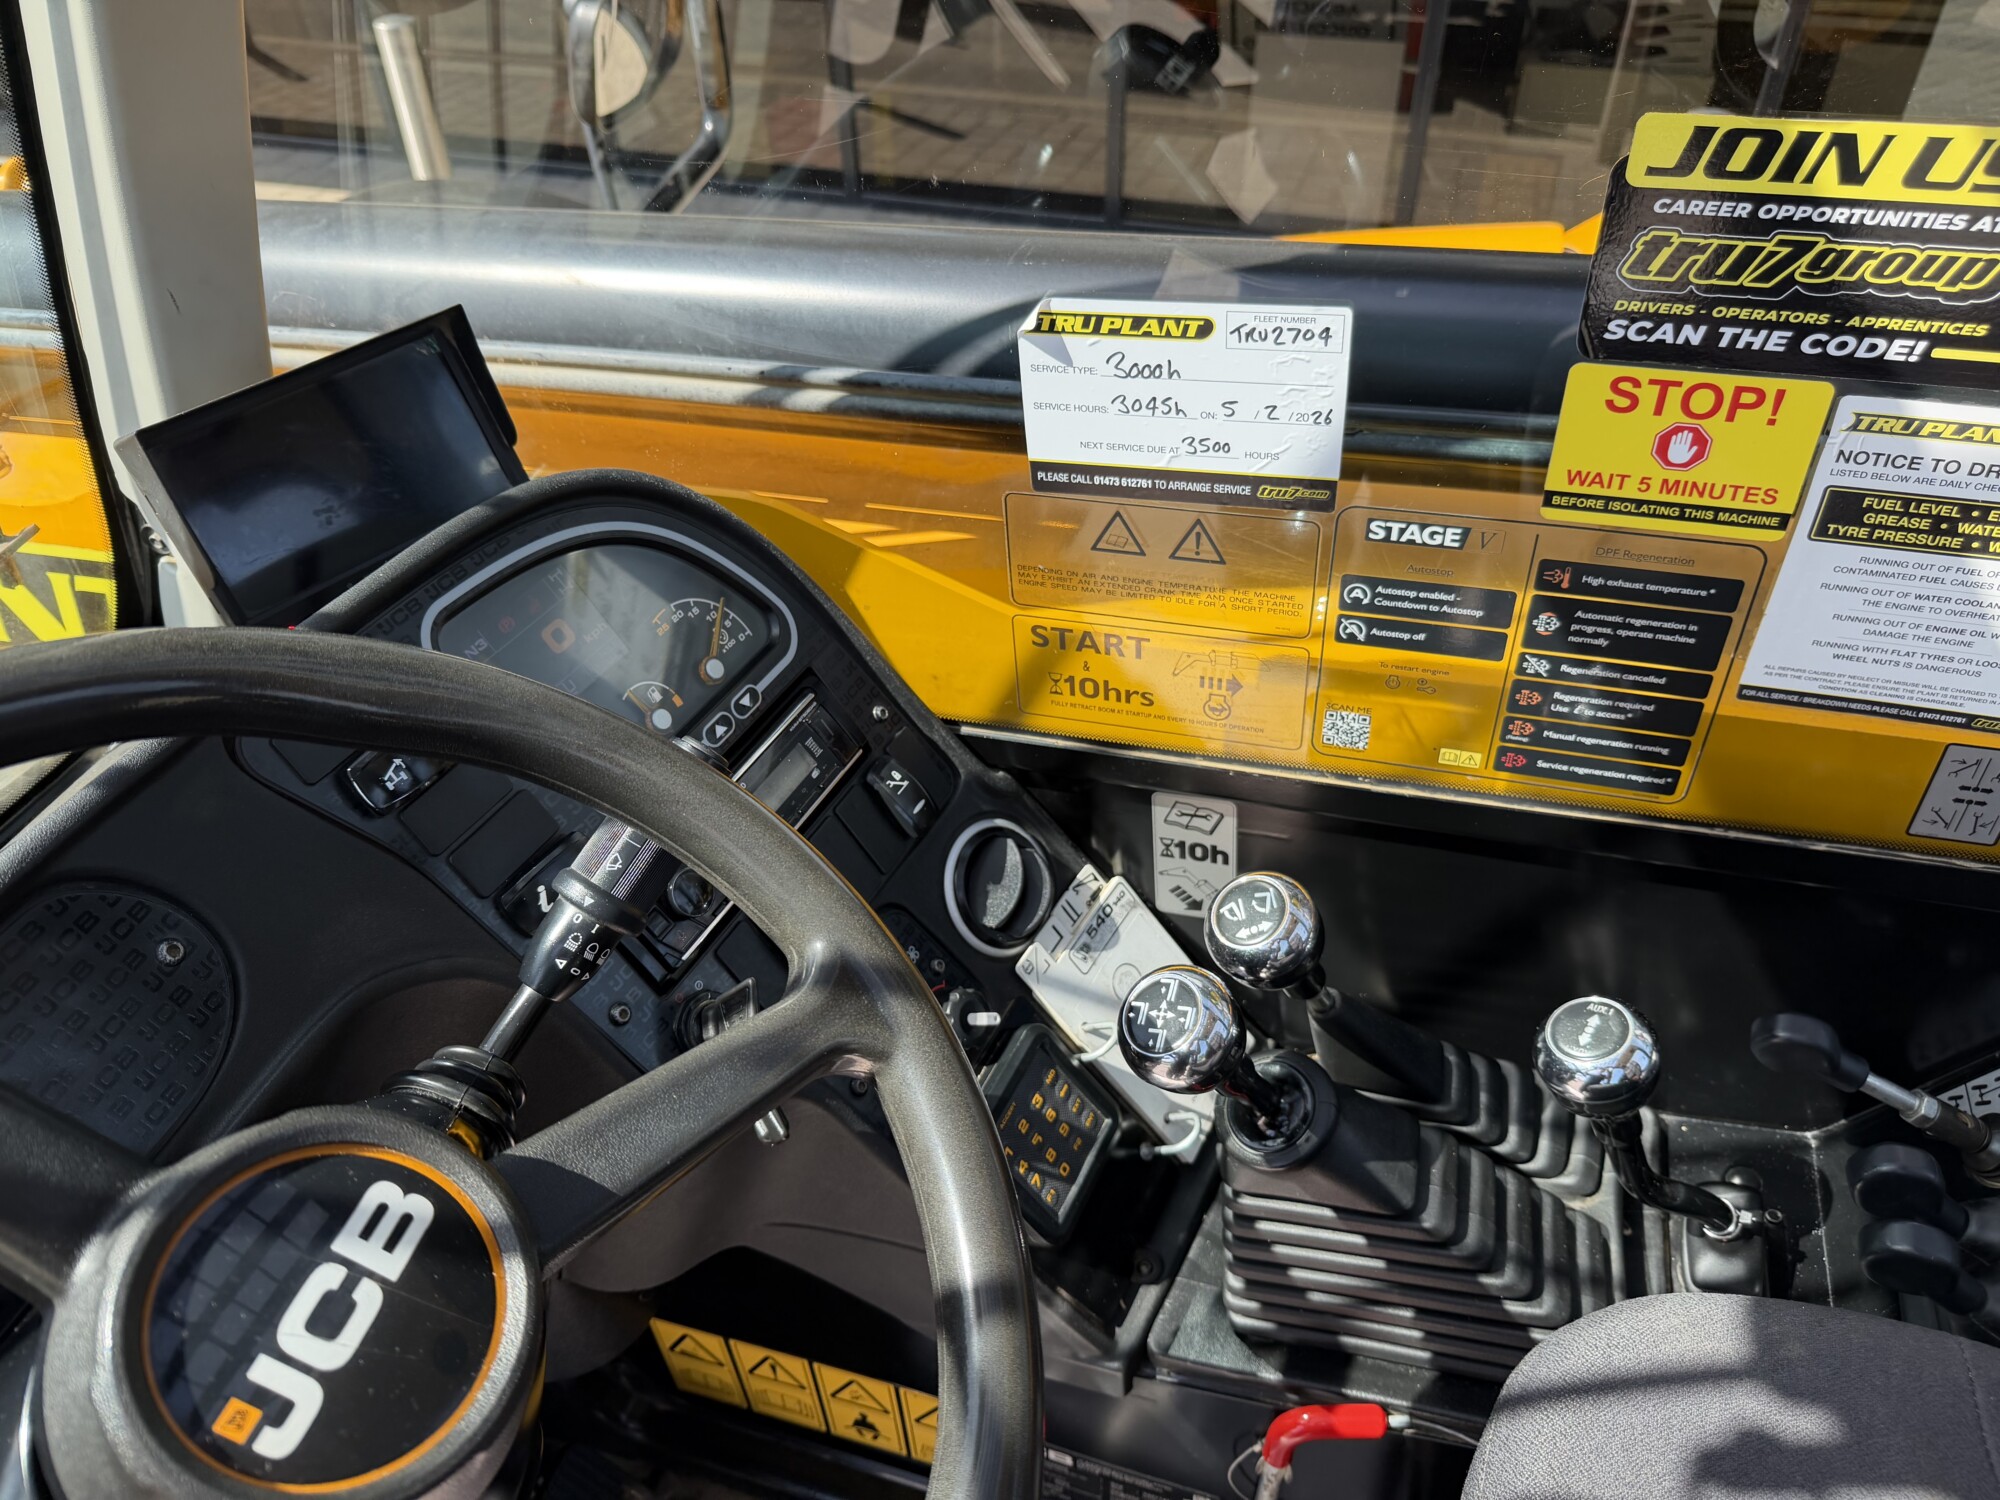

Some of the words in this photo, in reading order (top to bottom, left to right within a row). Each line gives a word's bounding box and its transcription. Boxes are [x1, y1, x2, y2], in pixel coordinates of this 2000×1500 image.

[1644, 125, 1897, 186] JOIN
[1654, 199, 1753, 219] CAREER
[1758, 203, 1968, 231] OPPORTUNITIES
[1621, 230, 2000, 293] tru7group
[1038, 314, 1099, 335] TRU
[1100, 317, 1204, 338] PLANT
[1254, 315, 1279, 323] FLEET
[1281, 316, 1317, 324] NUMBER
[1613, 300, 1696, 317] DRIVERS
[1712, 306, 1831, 325] OPERATORS
[1848, 316, 1990, 337] APPRENTICES
[1230, 324, 1332, 346] TRU2704
[1603, 319, 1704, 345] SCAN
[1717, 328, 1792, 353] THE
[1800, 334, 1933, 363] CODE!
[1031, 364, 1071, 375] SERVICE
[1073, 366, 1098, 376] TYPE:
[1106, 351, 1181, 379] 3000h
[1033, 402, 1072, 412] SERVICE
[1073, 403, 1109, 414] HOURS:
[1200, 411, 1217, 420] ON:
[1264, 405, 1280, 420] 2
[1604, 376, 1787, 426] STOP!
[1856, 415, 1920, 434] TRU
[1080, 441, 1105, 450] NEXT
[1106, 442, 1145, 453] SERVICE
[1147, 444, 1167, 454] DUE
[1168, 445, 1180, 454] AT
[1181, 437, 1231, 455] 3500
[1244, 451, 1280, 460] HOURS
[1835, 449, 1924, 471] NOTICE
[1931, 458, 1961, 474] TO
[1038, 472, 1067, 483] PLEASE
[1069, 474, 1093, 484] CALL
[1094, 476, 1120, 486] 01473
[1121, 477, 1152, 488] 612761
[1154, 479, 1167, 489] TO
[1168, 480, 1211, 492] ARRANGE
[1213, 483, 1251, 495] SERVICE
[1566, 469, 1631, 491] WAIT
[1637, 476, 1652, 493] 5
[1658, 478, 1779, 505] MINUTES
[1830, 468, 1868, 480] LISTED
[1870, 473, 1912, 484] BELOW
[1913, 477, 1936, 486] ARE
[1939, 480, 1972, 490] DAILY
[1551, 495, 1604, 510] BEFORE
[1607, 501, 1680, 517] ISOLATING
[1683, 508, 1714, 520] THIS
[1717, 512, 1780, 527] MACHINE
[1863, 497, 1905, 512] FUEL
[1909, 502, 1961, 518] LEVEL
[1863, 513, 1932, 530] GREASE
[1368, 520, 1463, 548] STAGE
[1480, 531, 1497, 549] V
[1827, 524, 1869, 538] TYRE
[1872, 529, 1963, 549] PRESSURE
[1595, 547, 1621, 557] DPF
[1623, 550, 1694, 566] Regeneration
[1859, 556, 1909, 568] RUNNING
[1912, 562, 1935, 571] OUT
[1938, 565, 1953, 573] OF
[1955, 567, 1983, 576] FUEL
[1406, 564, 1454, 577] Autostop
[1833, 566, 1916, 582] CONTAMINATED
[1919, 575, 1946, 585] FUEL
[1950, 578, 1994, 590] CAUSES
[1375, 586, 1417, 598] Autostop
[1418, 591, 1455, 601] enabled
[1581, 575, 1604, 586] High
[1607, 579, 1644, 590] exhaust
[1820, 582, 1869, 595] RUNNING
[1872, 588, 1894, 598] OUT
[1897, 591, 1912, 599] OF
[1915, 593, 1952, 604] WATER
[1019, 579, 1047, 588] ENGINE
[1051, 582, 1078, 591] SPEED
[1081, 586, 1101, 594] MAY
[1120, 590, 1155, 600] LIMITED
[1175, 597, 1194, 605] IDLE
[1198, 599, 1215, 607] FOR
[1232, 603, 1262, 612] SHORT
[1267, 607, 1302, 617] PERIOD.
[1374, 598, 1428, 611] Countdown
[1429, 604, 1439, 612] to
[1440, 605, 1484, 618] Autostop
[1862, 599, 1882, 608] THE
[1885, 602, 1925, 613] ENGINE
[1928, 606, 1942, 615] TO
[671, 610, 684, 623] 20
[688, 607, 700, 618] 15
[706, 611, 718, 622] 10
[1574, 610, 1624, 623] Automatic
[1626, 616, 1686, 630] regeneration
[1688, 623, 1698, 632] in
[1030, 624, 1151, 660] START
[1370, 627, 1412, 641] Autostop
[1412, 632, 1426, 641] off
[1567, 635, 1610, 647] normally
[1570, 623, 1614, 636] progress,
[1616, 628, 1654, 641] operate
[1655, 633, 1696, 644] machine
[1811, 640, 1859, 652] RUNNING
[1862, 645, 1888, 656] WITH
[1891, 649, 1917, 659] FLAT
[1920, 652, 1955, 664] TYRES
[1957, 657, 1973, 666] OR
[1082, 661, 1090, 671] &
[1391, 664, 1419, 673] restart
[1421, 668, 1450, 676] engine
[1560, 664, 1620, 680] Regeneration
[1622, 672, 1667, 684] cancelled
[1832, 653, 1868, 664] WHEEL
[1871, 657, 1900, 668] NUTS
[1903, 661, 1912, 670] IS
[1915, 663, 1982, 678] DANGEROUS
[1064, 676, 1155, 707] 10hrs
[1553, 691, 1613, 707] Regeneration
[1614, 698, 1655, 713] required
[1326, 702, 1354, 712] SCAN
[1357, 706, 1372, 714] ME
[1551, 703, 1569, 713] Use
[1584, 708, 1595, 716] to
[1543, 730, 1575, 742] Manual
[1576, 735, 1633, 749] regeneration
[1635, 742, 1670, 755] running
[1536, 760, 1569, 771] Service
[1570, 765, 1626, 780] regeneration
[1174, 840, 1230, 866] 10h
[1086, 903, 1114, 939] 540
[246, 1180, 435, 1460] JCB
